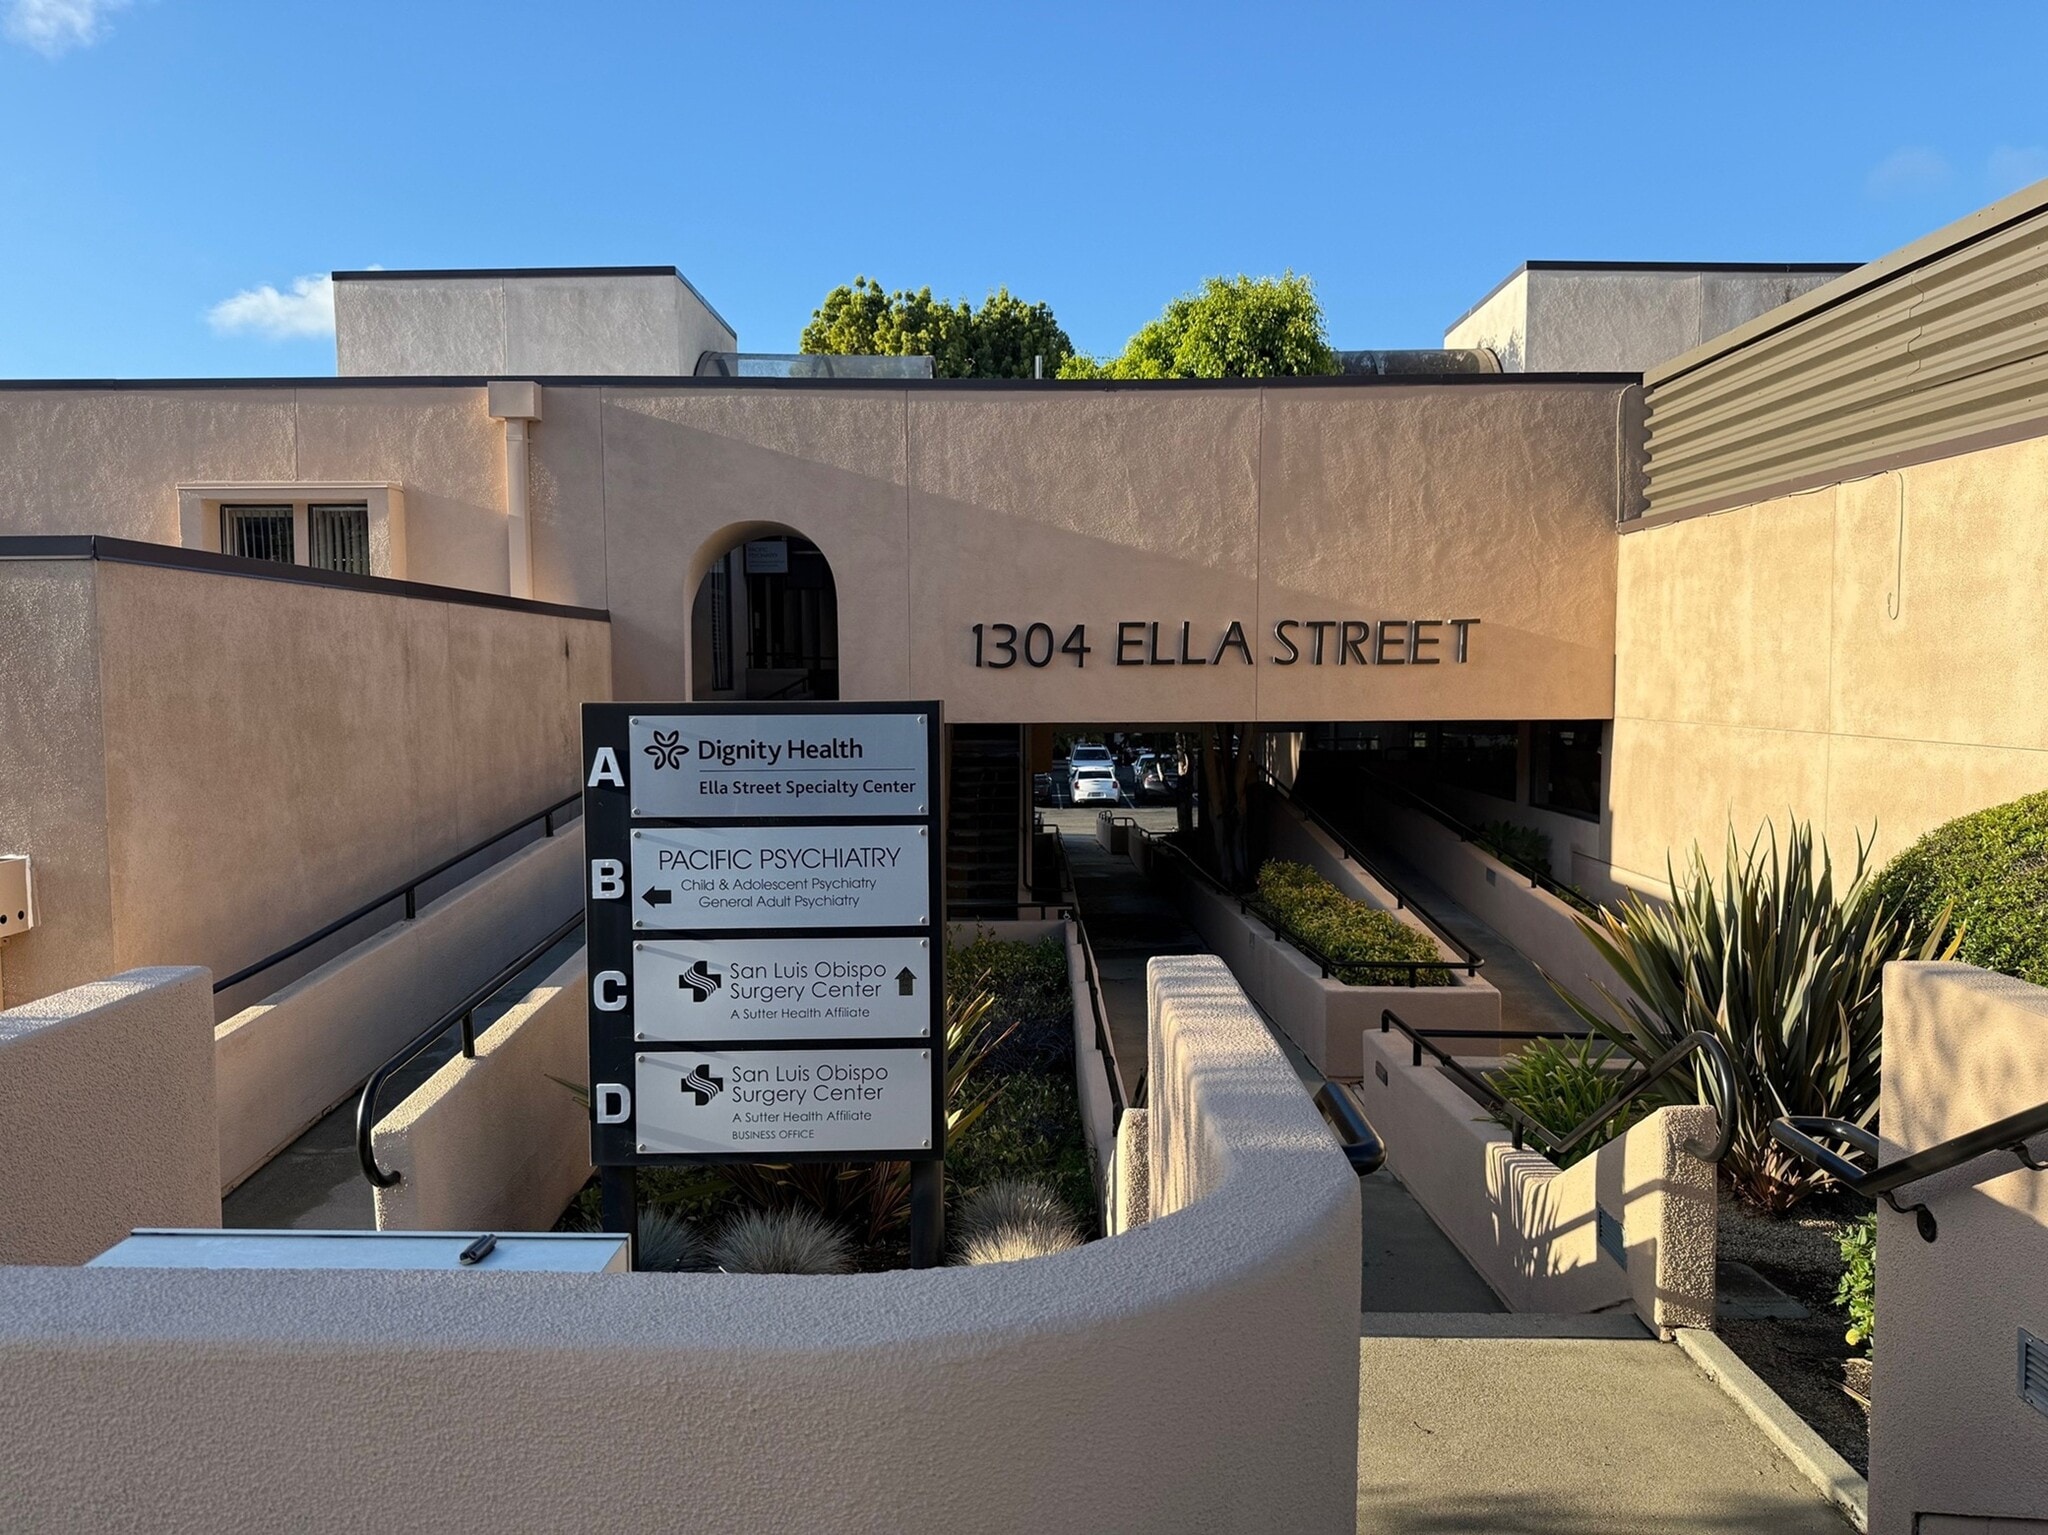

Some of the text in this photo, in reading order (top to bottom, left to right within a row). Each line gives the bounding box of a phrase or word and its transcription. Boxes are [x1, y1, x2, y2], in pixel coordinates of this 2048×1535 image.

[971, 618, 1481, 670] 1304 ELLA STREET
[698, 737, 863, 767] Dignity Health
[587, 746, 625, 788] A
[699, 778, 917, 799] Ella Street Specialty Center
[659, 847, 902, 871] PACIFIC PSYCHIATRY
[591, 858, 625, 900] B
[680, 876, 877, 892] Child & Adolescent Psychiatry
[698, 892, 860, 909] General Adult Psychiatry
[729, 960, 887, 982] San Luis Obispo
[593, 970, 628, 1012] C
[730, 980, 882, 1003] Surgery Center
[730, 1006, 871, 1020] A Sutter Health Affiliate
[731, 1063, 889, 1086] San Luis Obispo
[595, 1082, 631, 1125] D
[731, 1082, 884, 1107] Surgery Center
[731, 1109, 872, 1123] A Sutter Health Affiliate
[732, 1128, 815, 1141] BUSINESS OFFICE
